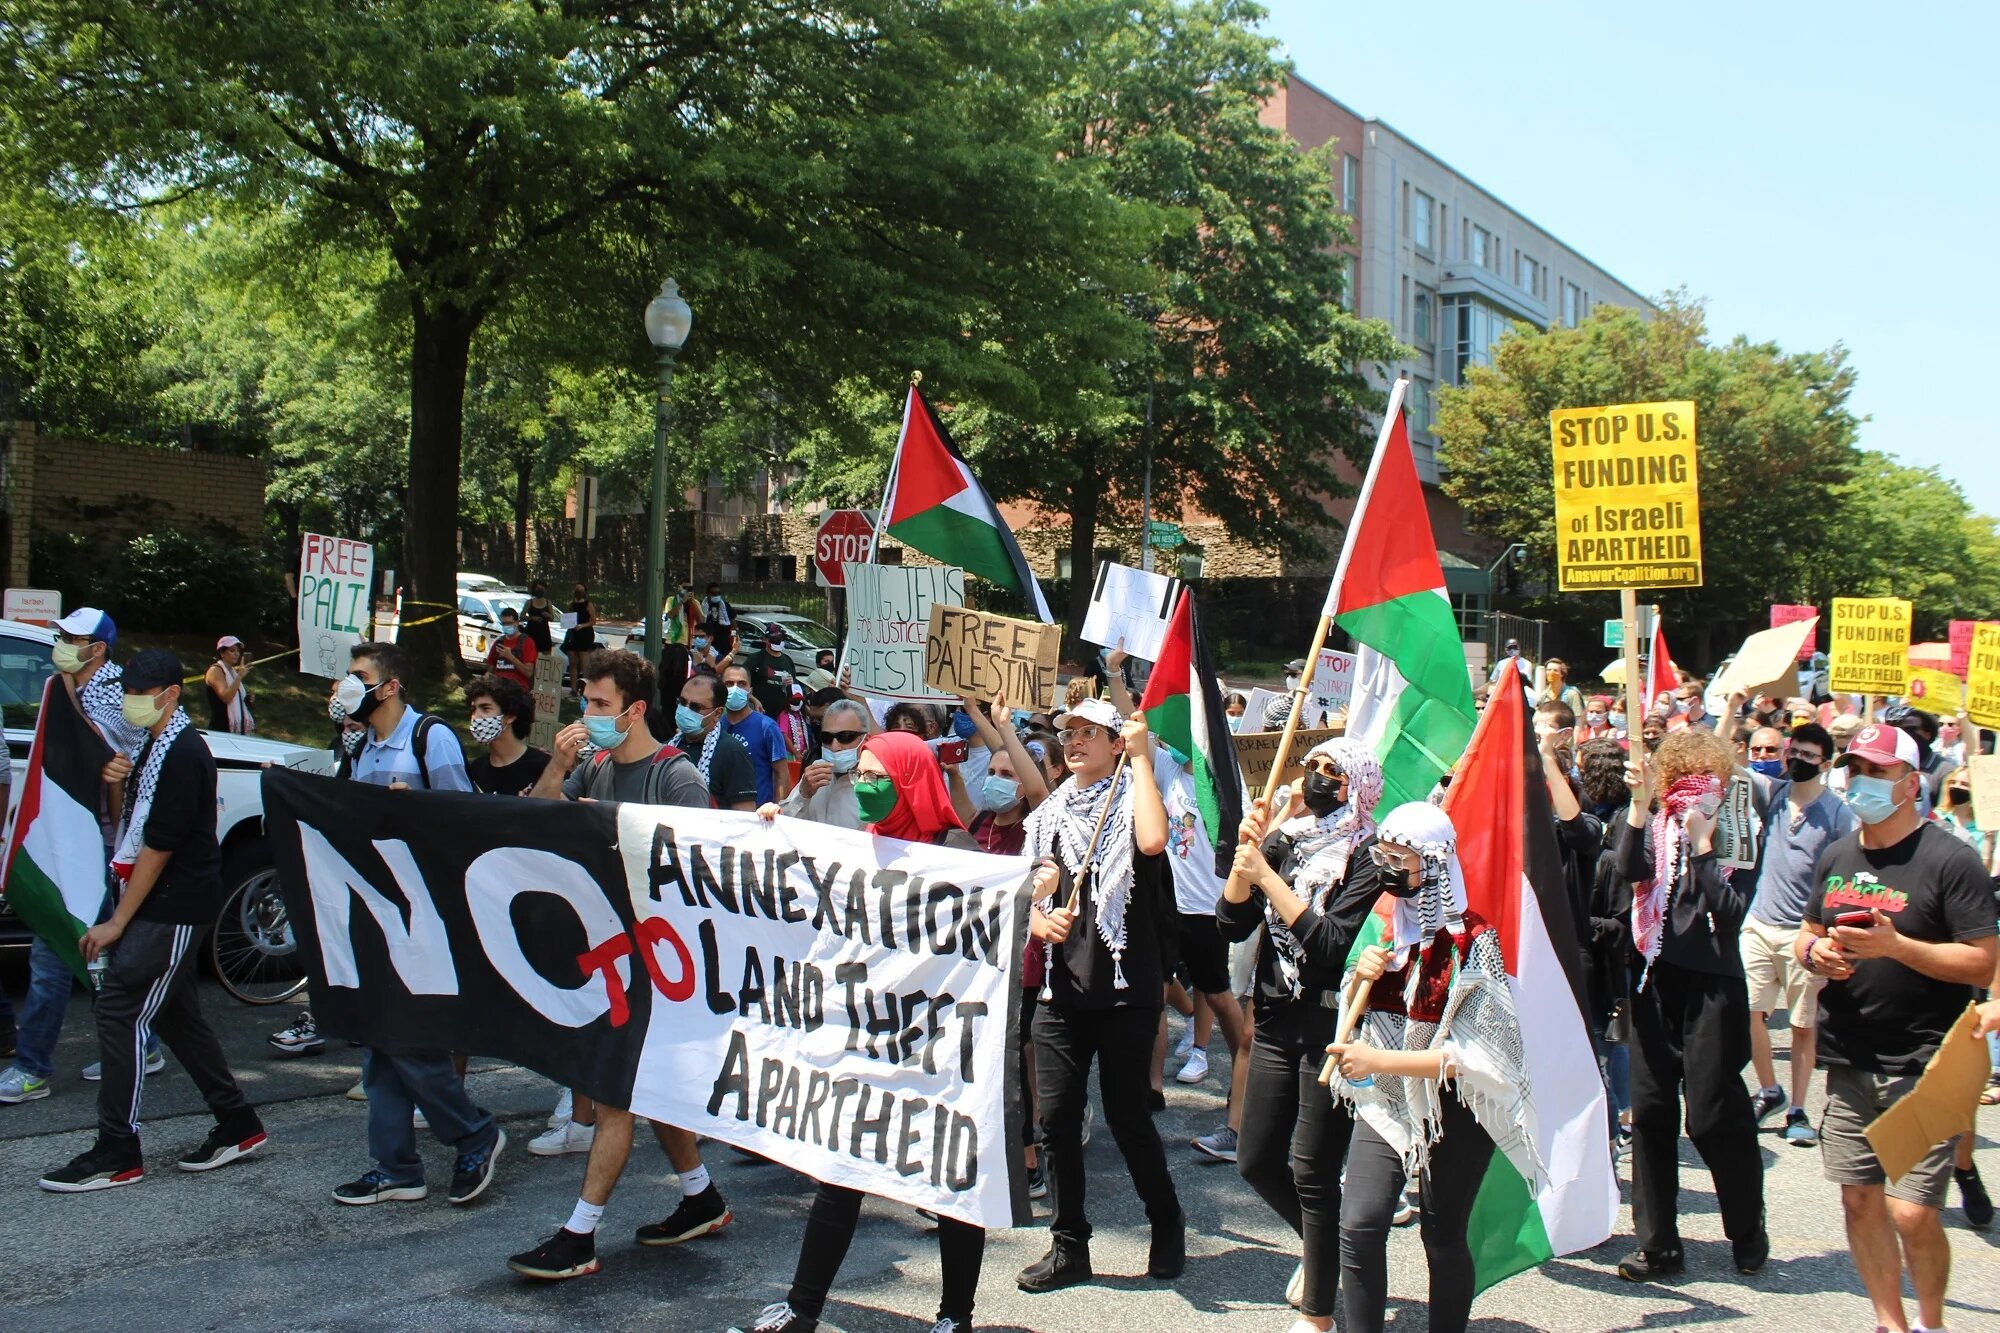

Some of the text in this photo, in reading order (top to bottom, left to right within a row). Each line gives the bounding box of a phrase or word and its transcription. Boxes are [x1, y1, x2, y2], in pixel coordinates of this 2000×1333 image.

[1559, 412, 1687, 447] STOP U.S.
[1563, 454, 1687, 489] FUNDING
[1571, 502, 1683, 533] of Israeli
[306, 535, 368, 577] FREE
[818, 534, 871, 562] STOP
[1567, 535, 1691, 563] APARTHEID
[843, 564, 892, 621] YOUNG
[1566, 567, 1695, 584] AnswerCoalition.org
[301, 575, 366, 633] PALI
[1837, 603, 1907, 621] STOP U.S.
[856, 619, 927, 645] FOR JUSTICE
[940, 609, 1042, 661] FREE
[1837, 625, 1904, 643] FUNDING
[926, 635, 1055, 709] PALESTINE
[1318, 653, 1352, 673] STOP
[1835, 666, 1904, 682] APARTHEID
[1852, 650, 1900, 667] Israeli
[647, 822, 1006, 970] ANNEXATION
[295, 818, 632, 1029] NO
[577, 914, 697, 1028] TO
[699, 918, 990, 1084] LAND THEFT
[706, 1029, 980, 1193] APARTHEID
